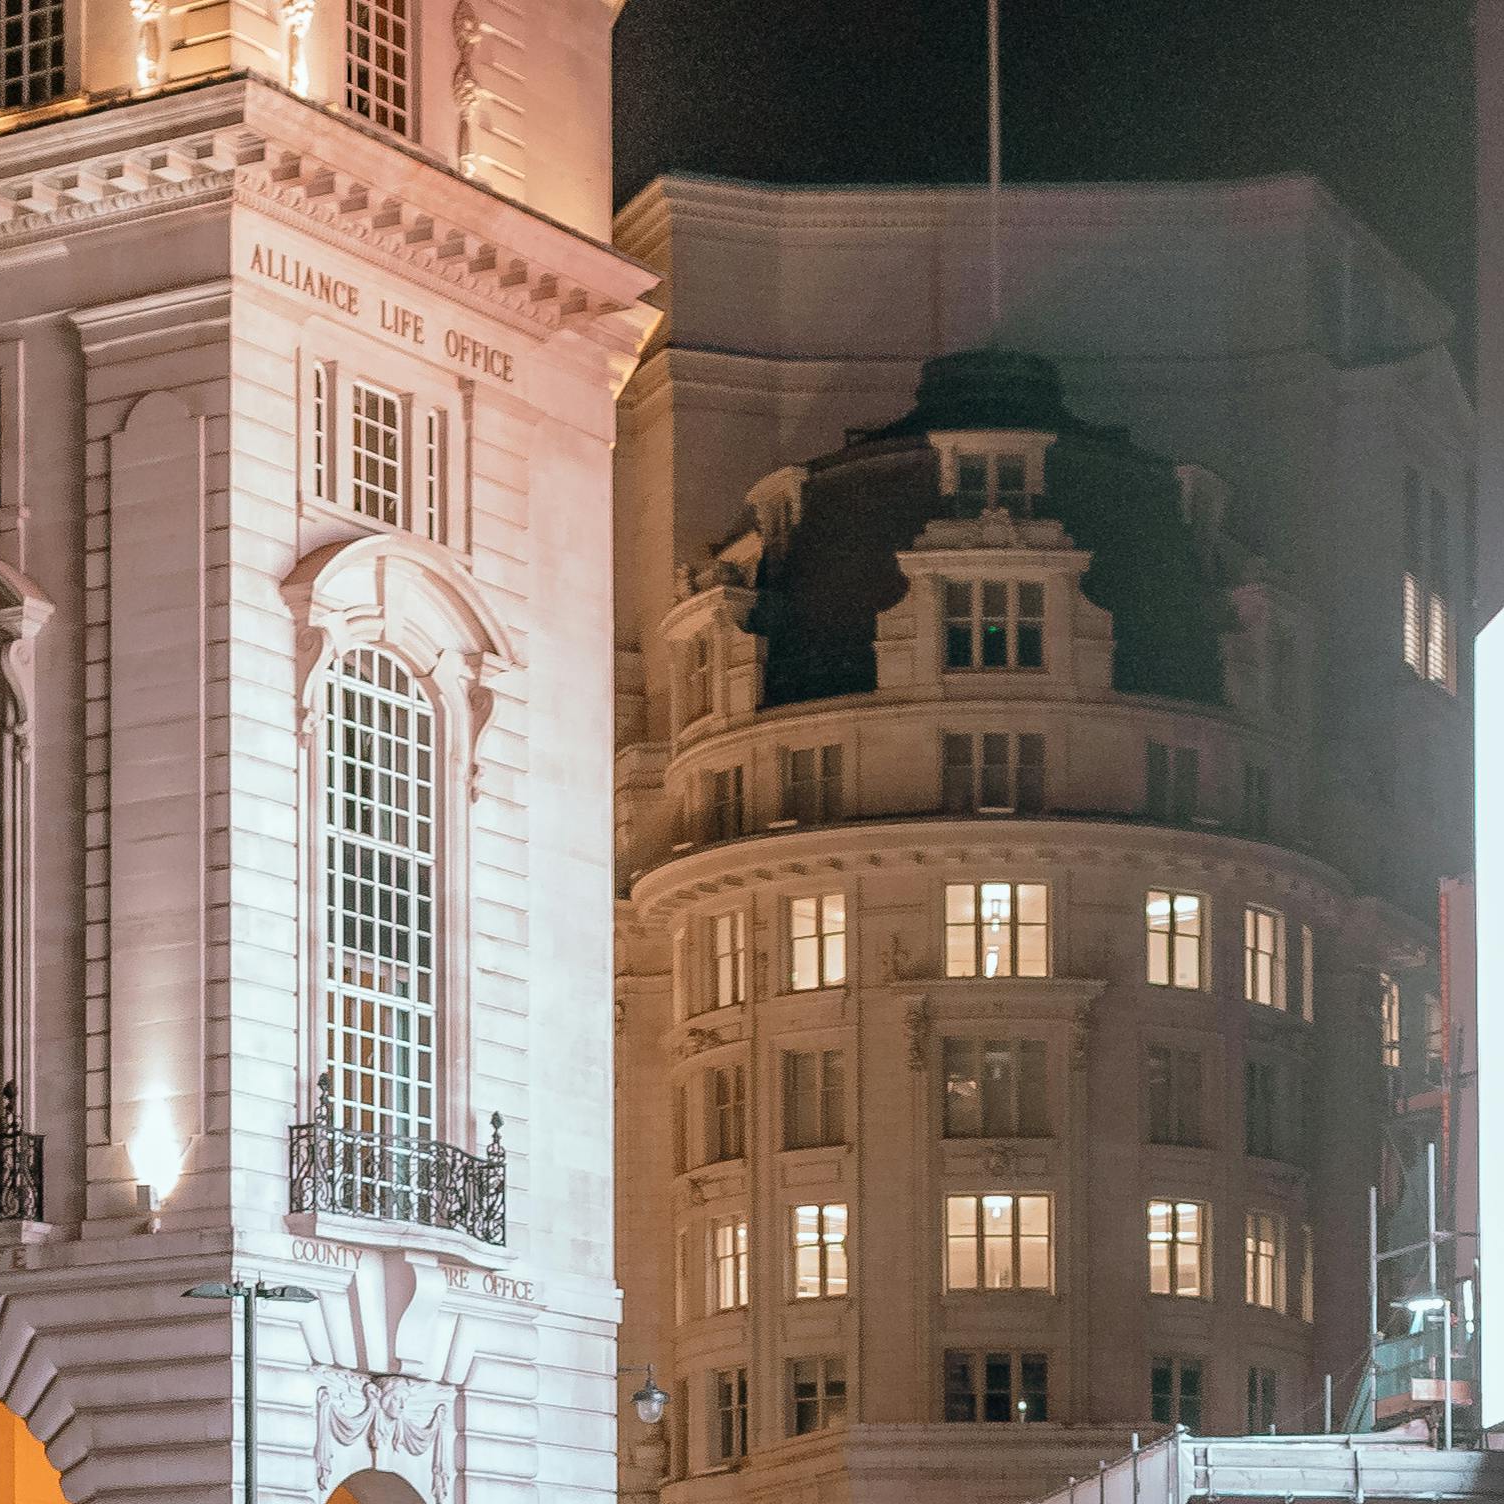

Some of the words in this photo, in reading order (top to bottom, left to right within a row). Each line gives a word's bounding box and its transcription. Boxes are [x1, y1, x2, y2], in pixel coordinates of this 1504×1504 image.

[250, 243, 360, 316] ALLIANCE
[380, 300, 425, 344] LIFE
[445, 329, 514, 383] OFFICE
